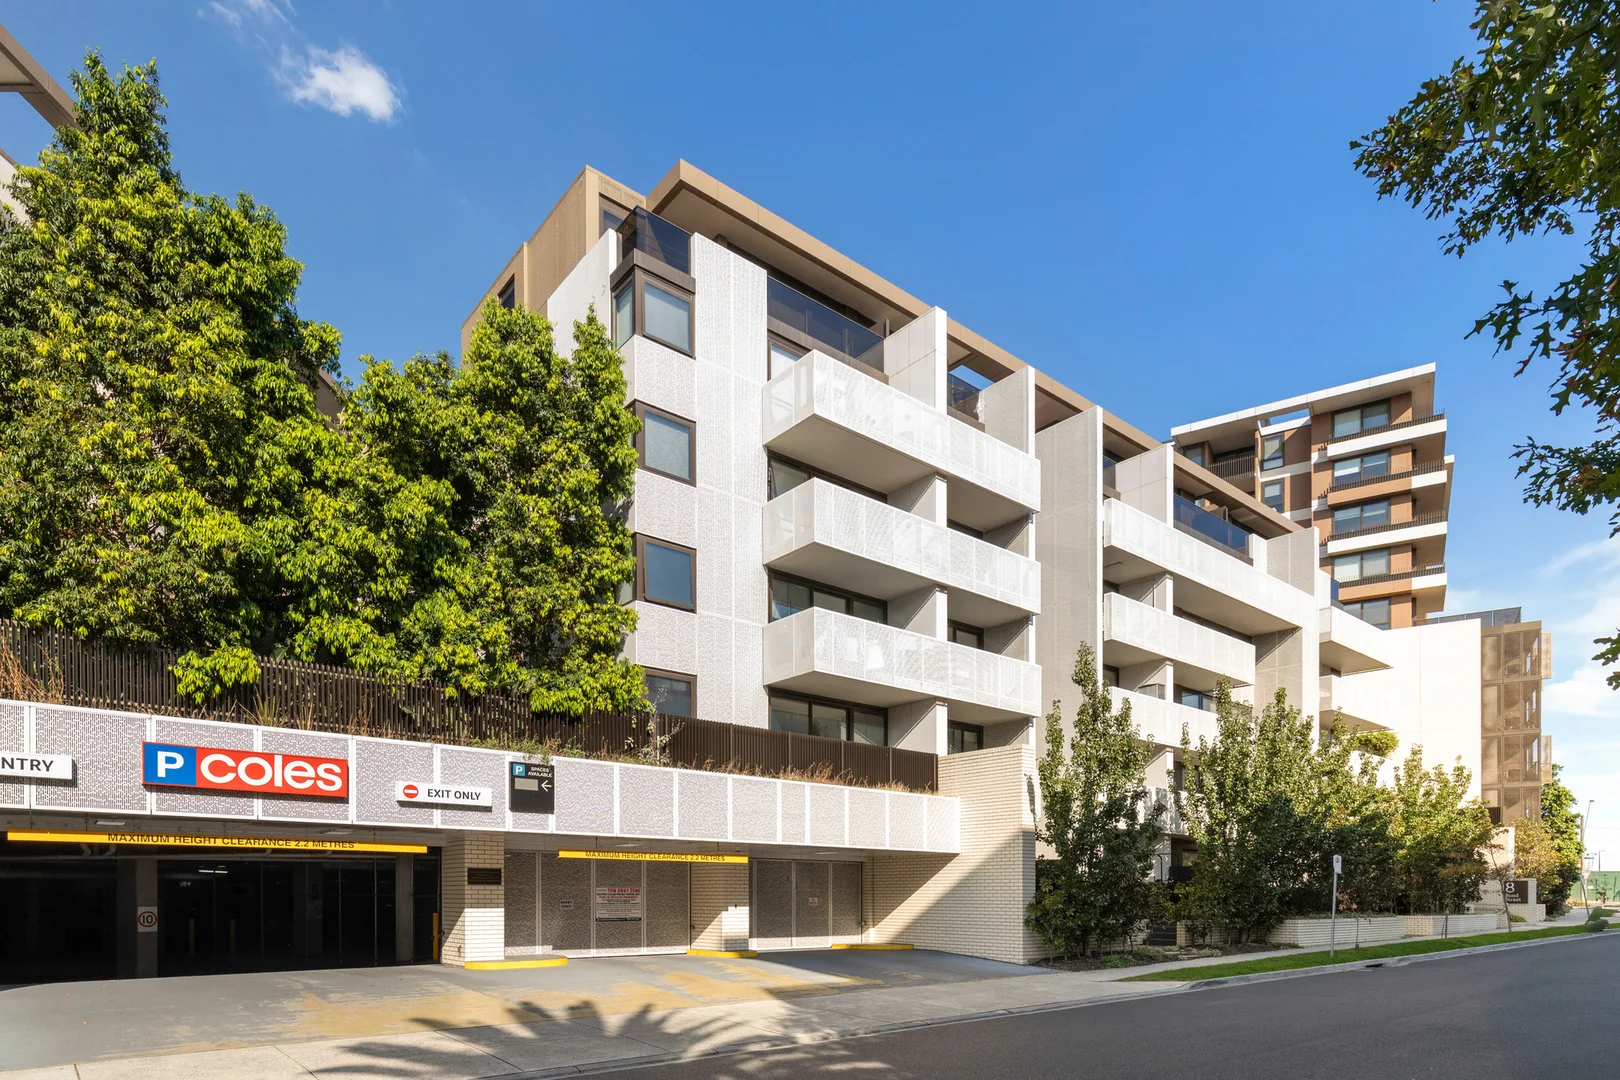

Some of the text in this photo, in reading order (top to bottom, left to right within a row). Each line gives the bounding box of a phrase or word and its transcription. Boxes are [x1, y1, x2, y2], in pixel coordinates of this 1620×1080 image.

[1, 757, 54, 771] NTRY
[515, 765, 523, 775] P
[157, 750, 343, 792] P coles
[427, 788, 482, 801] EXIT ONLY
[107, 833, 355, 849] MAXIMUM HEIGHT CLEARANCE 2.2 METRES
[585, 851, 621, 859] MAXIMUM
[649, 853, 689, 861] CLEARANCE
[1506, 882, 1515, 893] 8
[141, 915, 154, 924] 10
